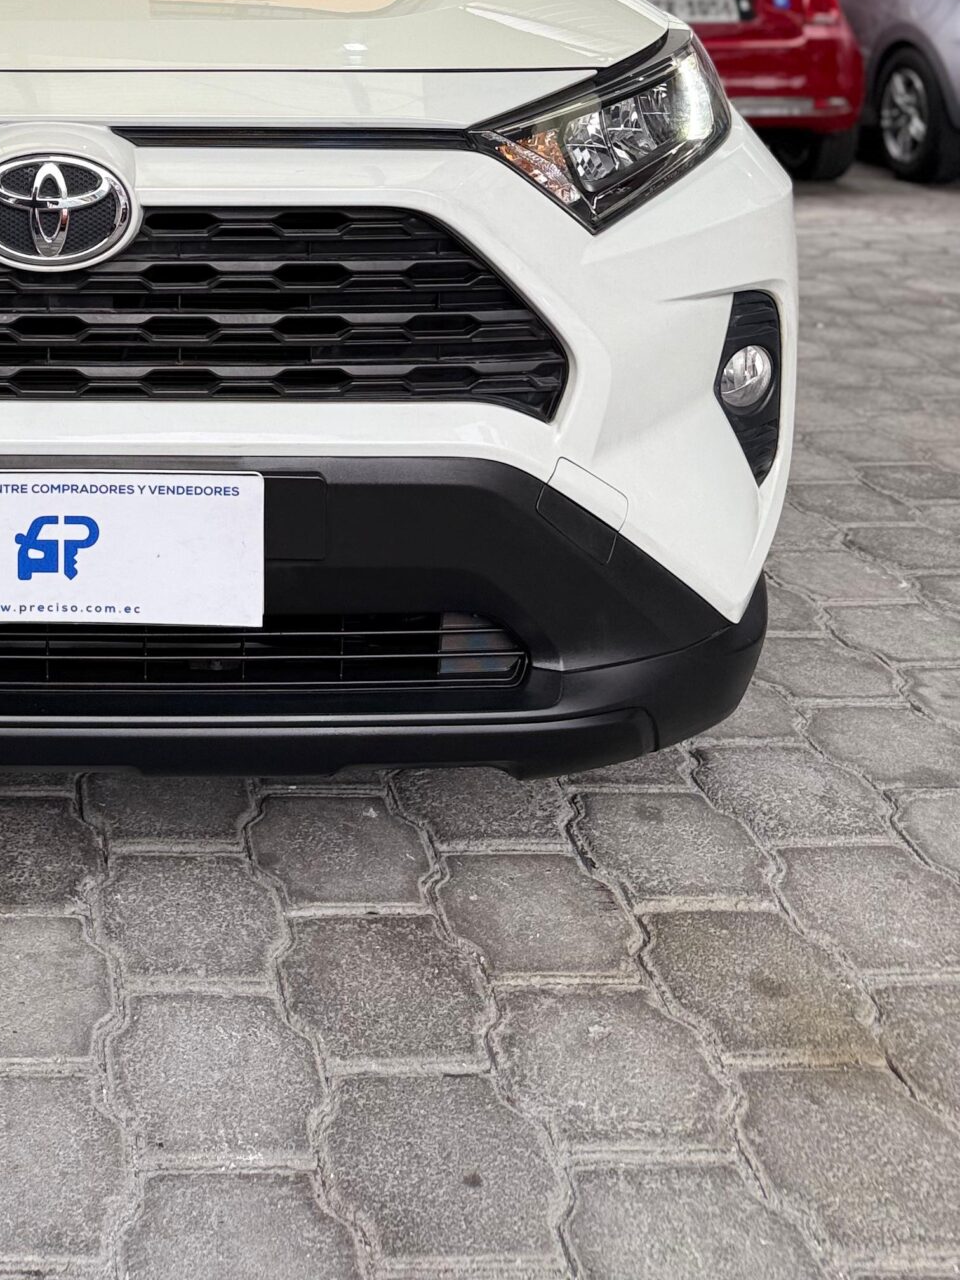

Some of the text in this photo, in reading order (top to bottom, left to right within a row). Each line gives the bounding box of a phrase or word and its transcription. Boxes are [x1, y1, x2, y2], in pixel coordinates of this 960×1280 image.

[31, 484, 135, 495] COMPRADORES
[137, 485, 146, 494] Y
[148, 485, 240, 496] VENDEDORES
